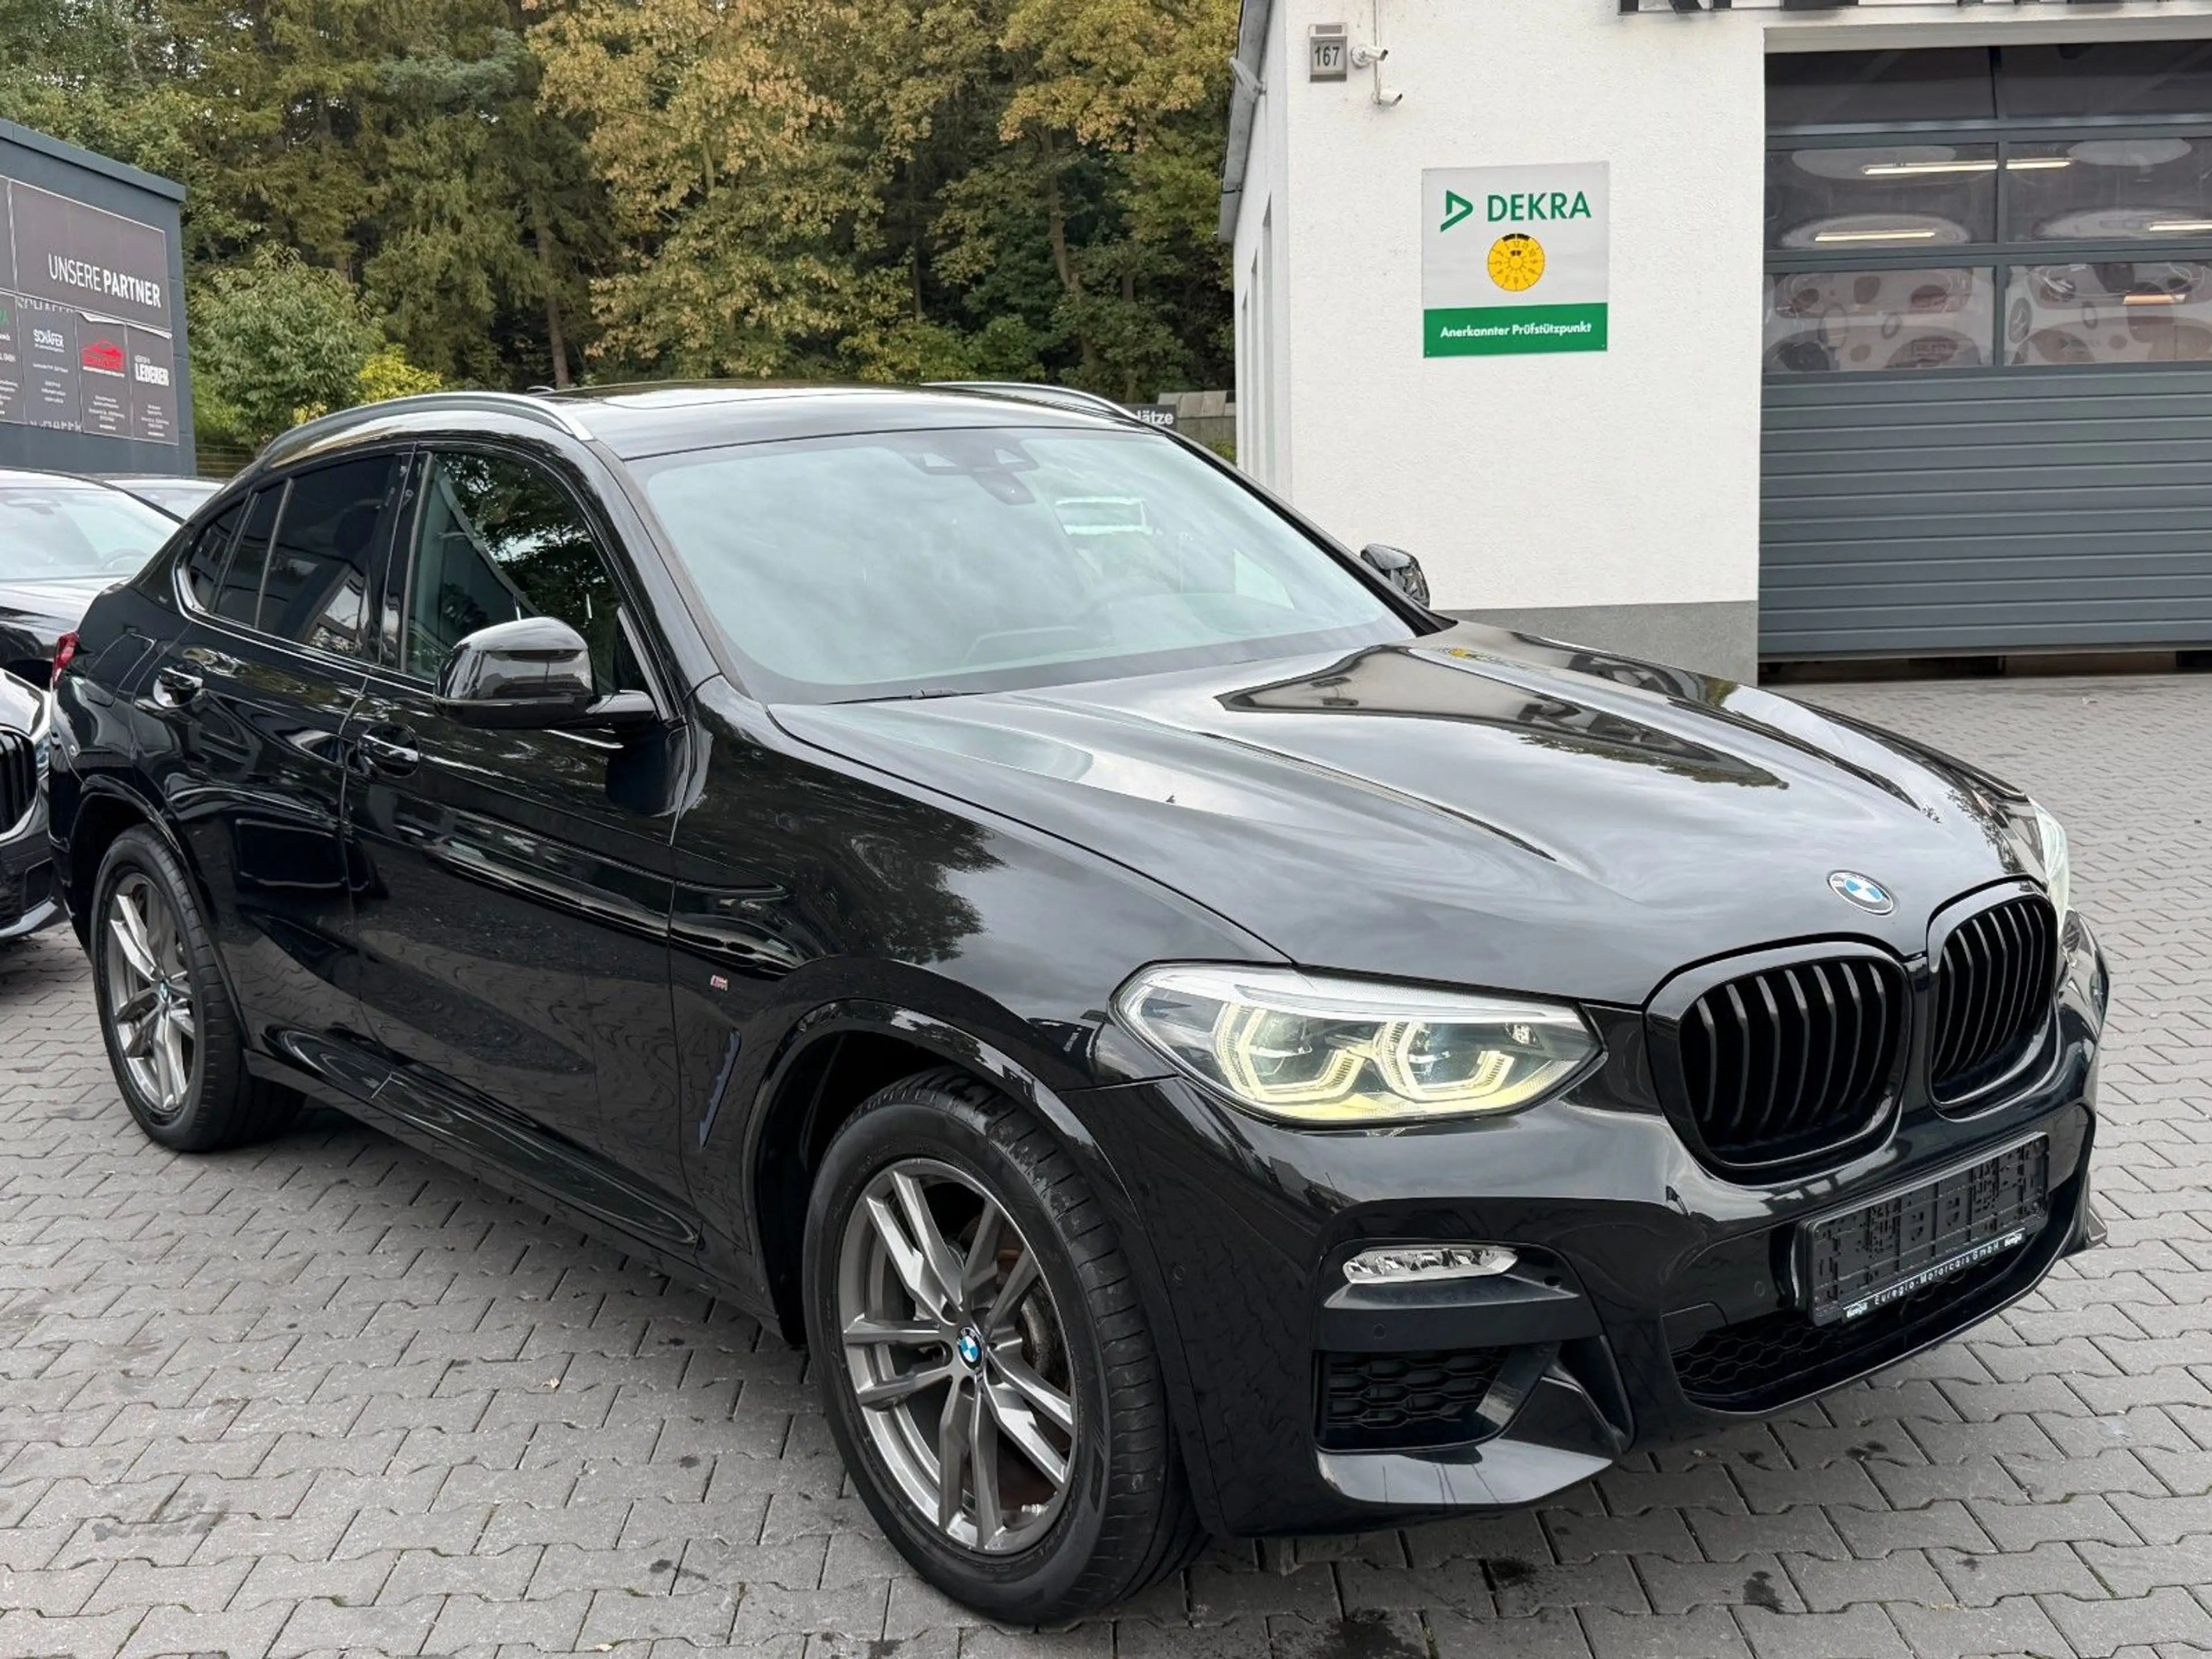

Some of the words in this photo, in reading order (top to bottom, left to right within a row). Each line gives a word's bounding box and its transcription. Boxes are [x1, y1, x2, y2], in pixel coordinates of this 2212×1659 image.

[1315, 46, 1340, 67] 167
[1487, 191, 1592, 222] DEKRA
[48, 252, 102, 291] UNSERE
[103, 269, 162, 308] PARTNER
[1440, 325, 1510, 338] Anerkannter
[1512, 321, 1592, 336] Prüfstützpunkt
[1136, 410, 1174, 425] lätze
